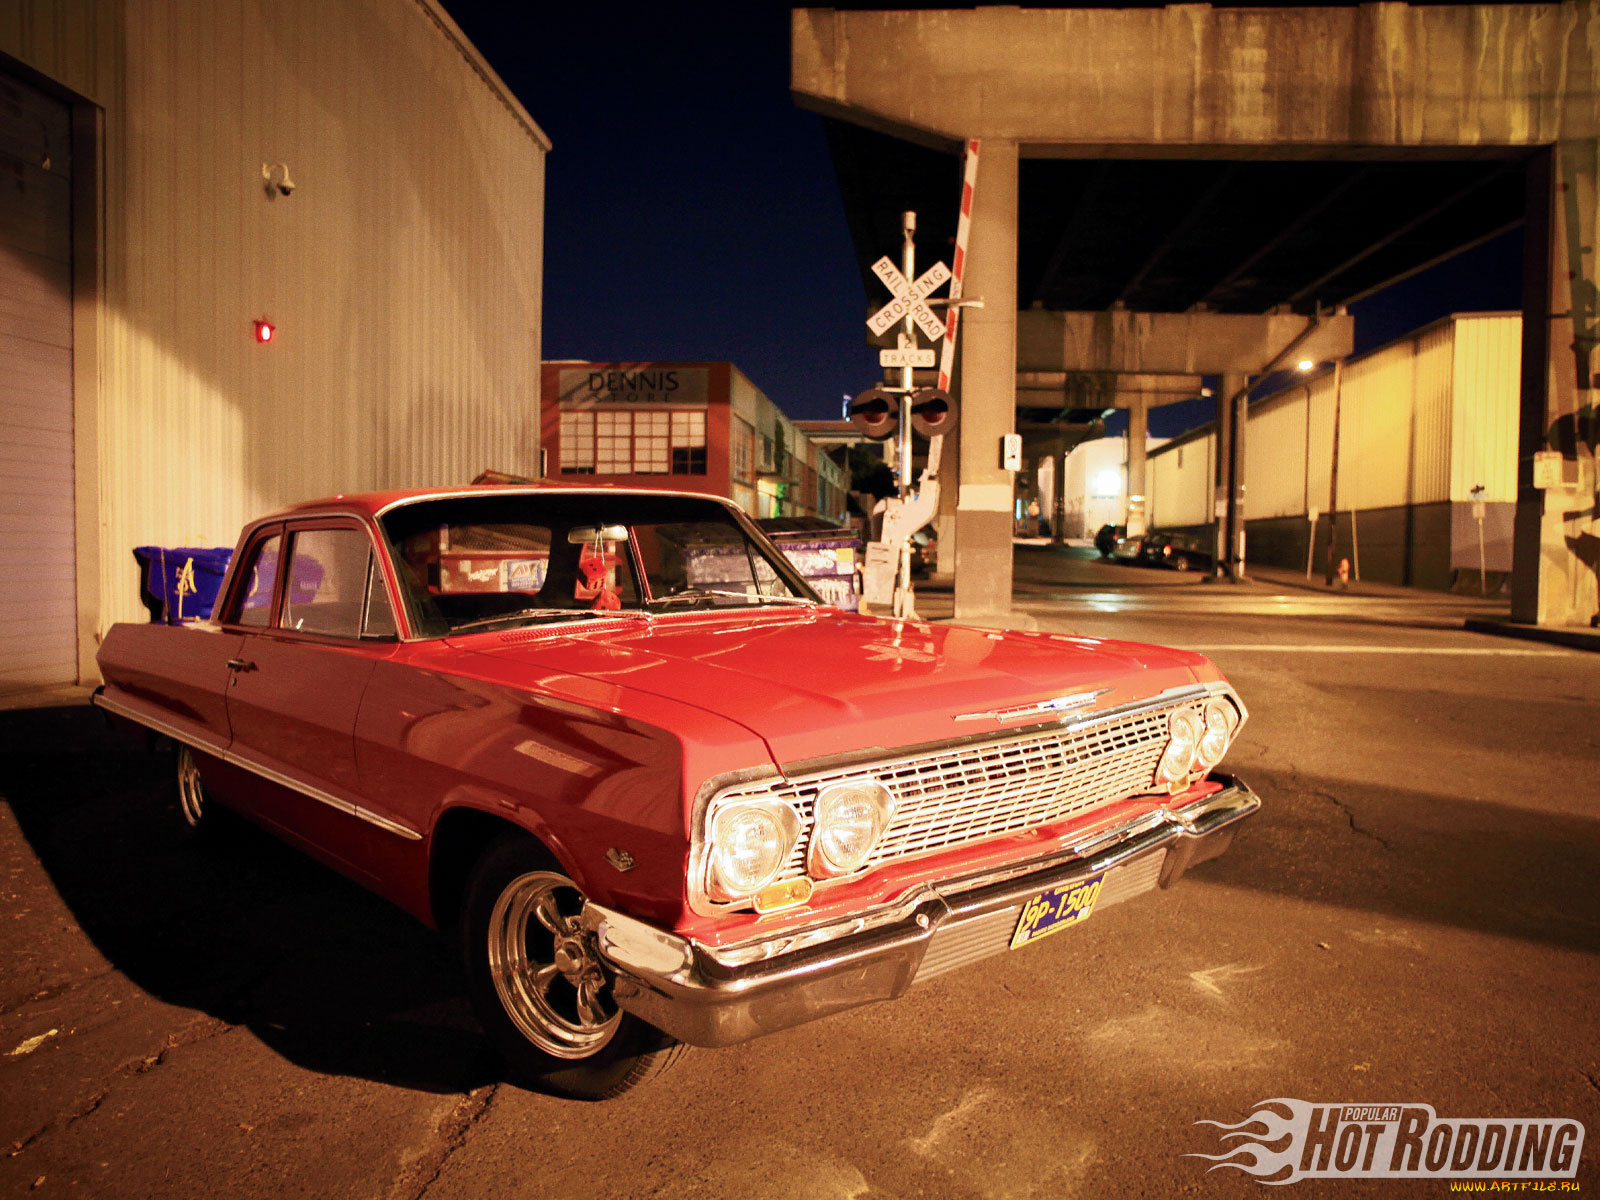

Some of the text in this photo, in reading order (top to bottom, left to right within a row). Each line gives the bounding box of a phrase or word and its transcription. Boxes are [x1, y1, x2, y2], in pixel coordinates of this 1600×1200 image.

[875, 269, 944, 328] CROSSING
[877, 261, 941, 338] RAIL ROAD
[884, 353, 932, 363] TRACKS
[590, 372, 680, 391] DENNIS
